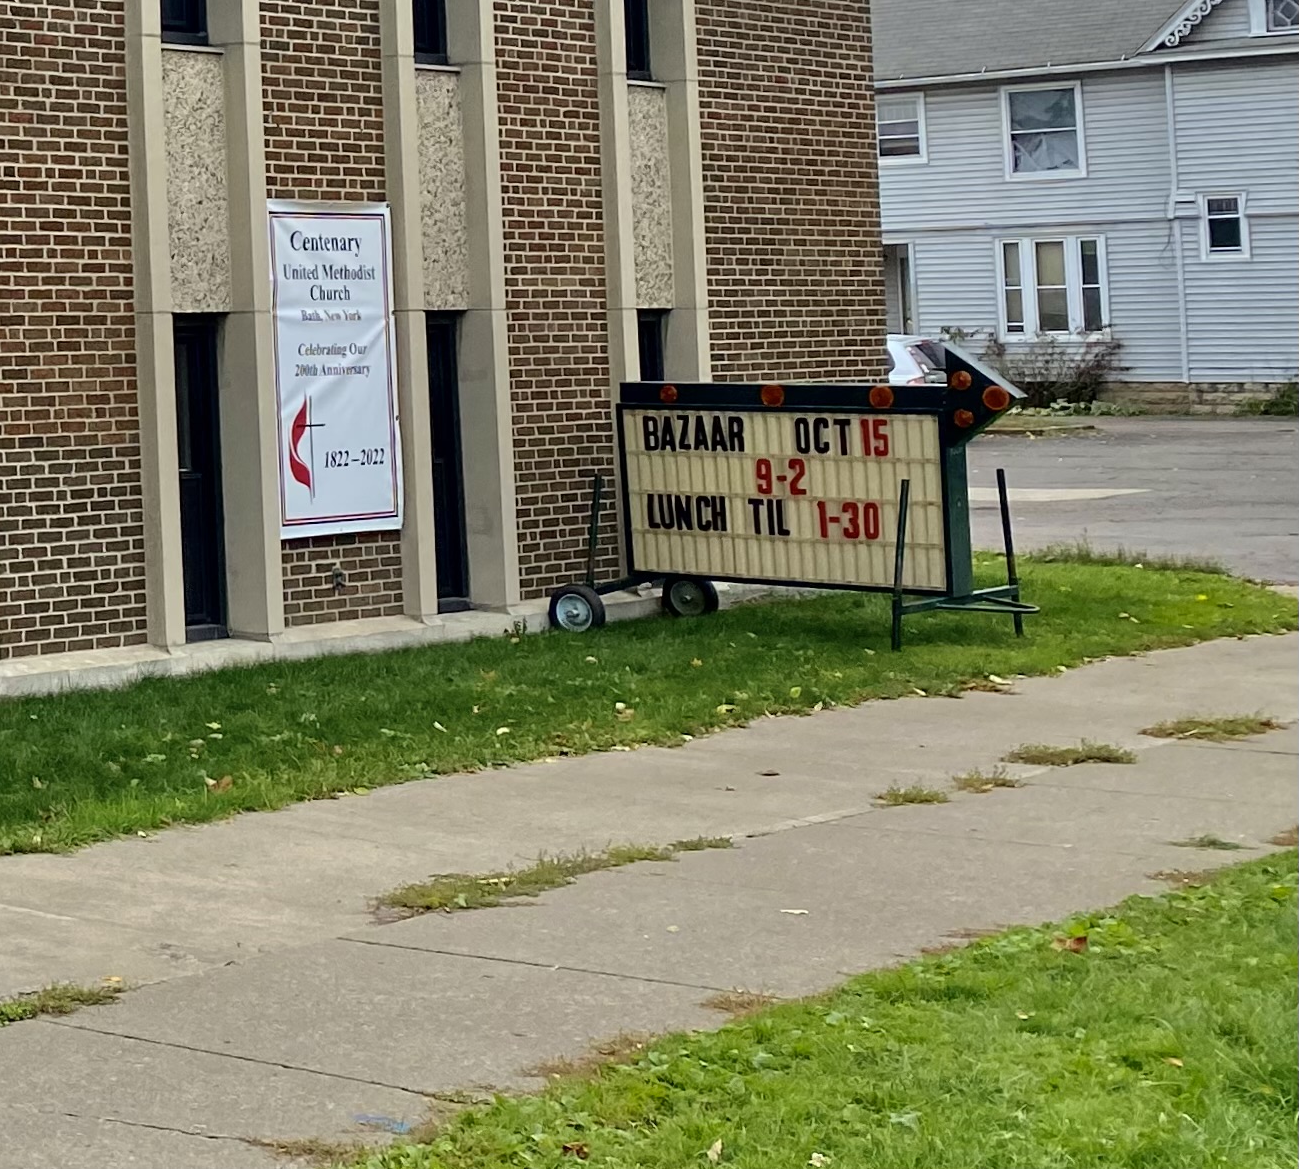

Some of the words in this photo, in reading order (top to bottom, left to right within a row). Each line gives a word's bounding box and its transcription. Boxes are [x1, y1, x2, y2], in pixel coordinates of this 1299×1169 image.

[290, 230, 362, 257] Centenary
[283, 263, 319, 280] United
[322, 264, 376, 281] Methodist
[310, 284, 351, 301] Church
[324, 310, 342, 322] New
[343, 310, 362, 321] York
[298, 342, 347, 358] Celebrating
[349, 342, 368, 355] Our
[295, 364, 318, 377] 200th
[319, 364, 371, 378] Anniversary
[643, 415, 745, 452] BAZAAR
[794, 417, 851, 456] OCT
[859, 418, 889, 457] 15
[755, 458, 807, 496] 9-2
[646, 493, 728, 532] LUNCH
[748, 498, 791, 537] TIL
[816, 500, 880, 540] 1-30
